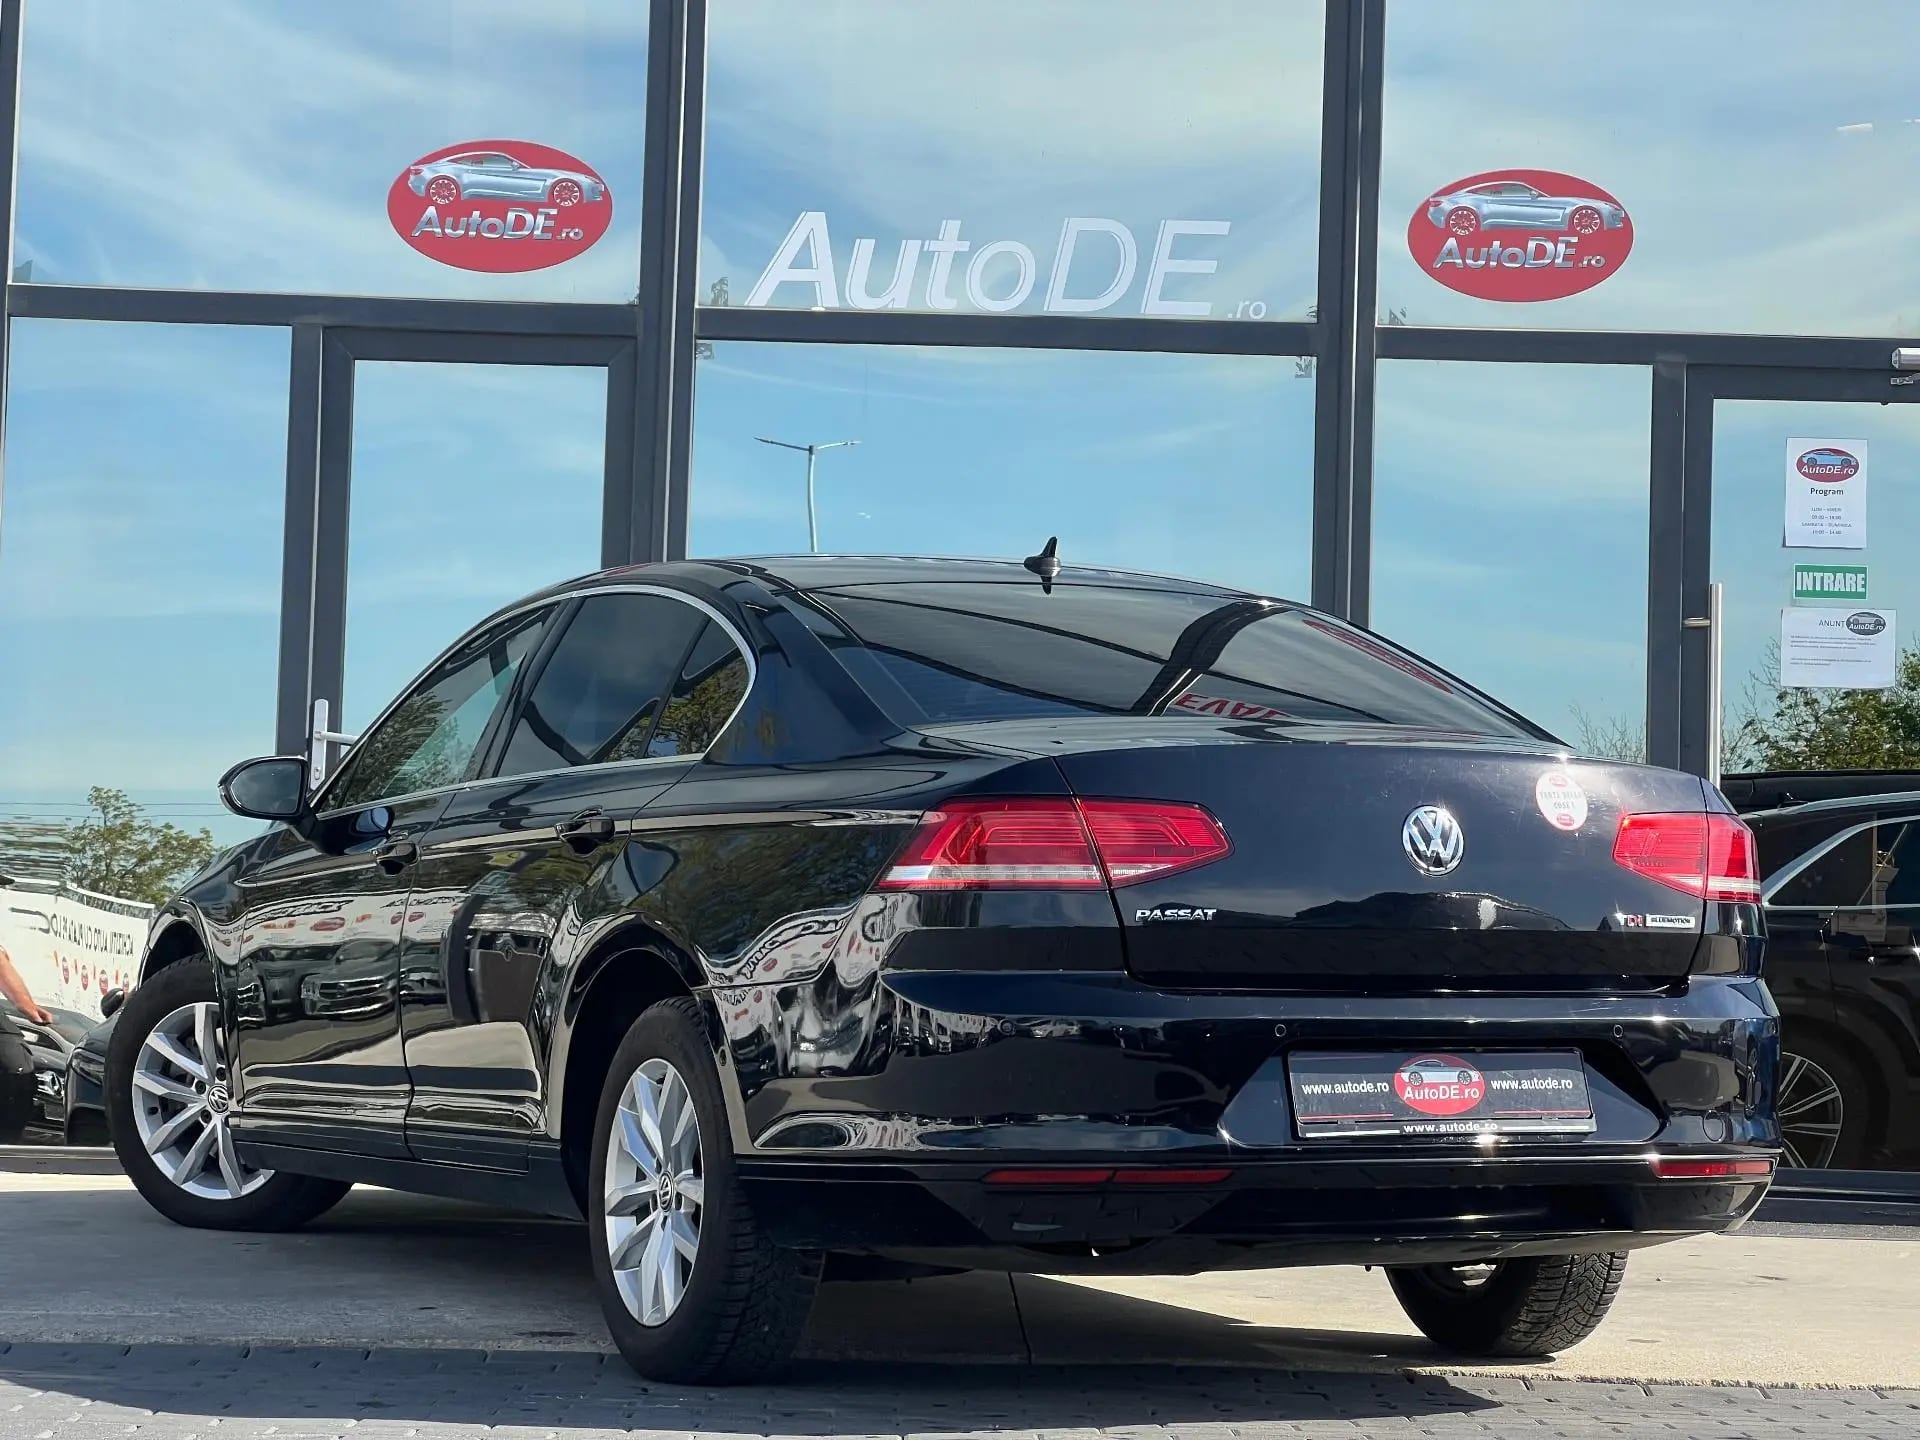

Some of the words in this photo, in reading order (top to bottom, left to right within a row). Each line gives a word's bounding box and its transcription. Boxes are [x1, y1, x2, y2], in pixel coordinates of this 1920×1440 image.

[411, 205, 584, 241] AutoDE.ro
[1433, 236, 1606, 269] AutoDE.ro
[744, 211, 1267, 320] AutoDE.ro
[1801, 465, 1855, 475] AutoDE.ro
[1810, 487, 1844, 496] Program
[1796, 571, 1865, 592] INTRARE
[1136, 908, 1217, 921] PASSAT
[1301, 1081, 1389, 1095] www.autode.ro
[1490, 1077, 1573, 1090] www.autode.ro
[1403, 1084, 1480, 1101] AutoDE.ro
